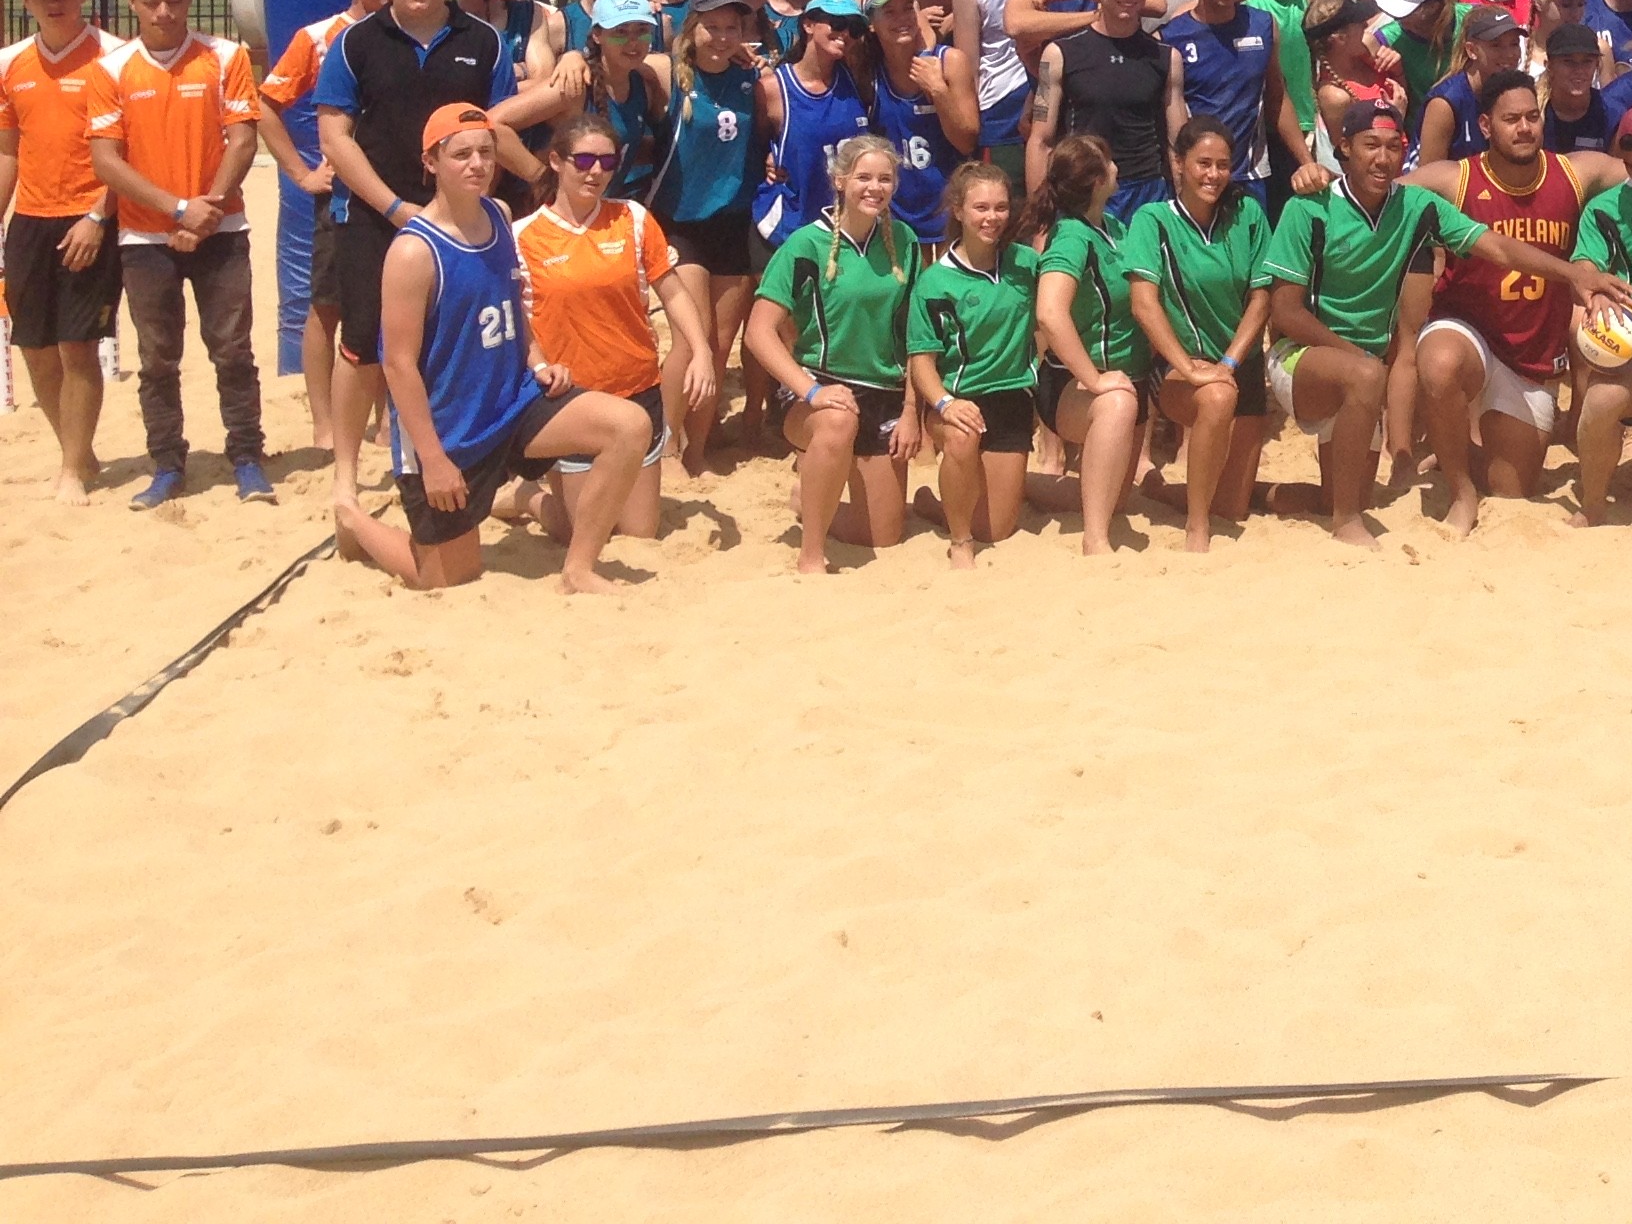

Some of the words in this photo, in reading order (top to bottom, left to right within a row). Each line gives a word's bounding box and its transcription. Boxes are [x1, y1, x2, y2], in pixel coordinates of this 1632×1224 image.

[1185, 42, 1198, 63] 3
[717, 110, 738, 142] 8
[1493, 217, 1571, 251] EVELAND
[479, 300, 517, 350] 21
